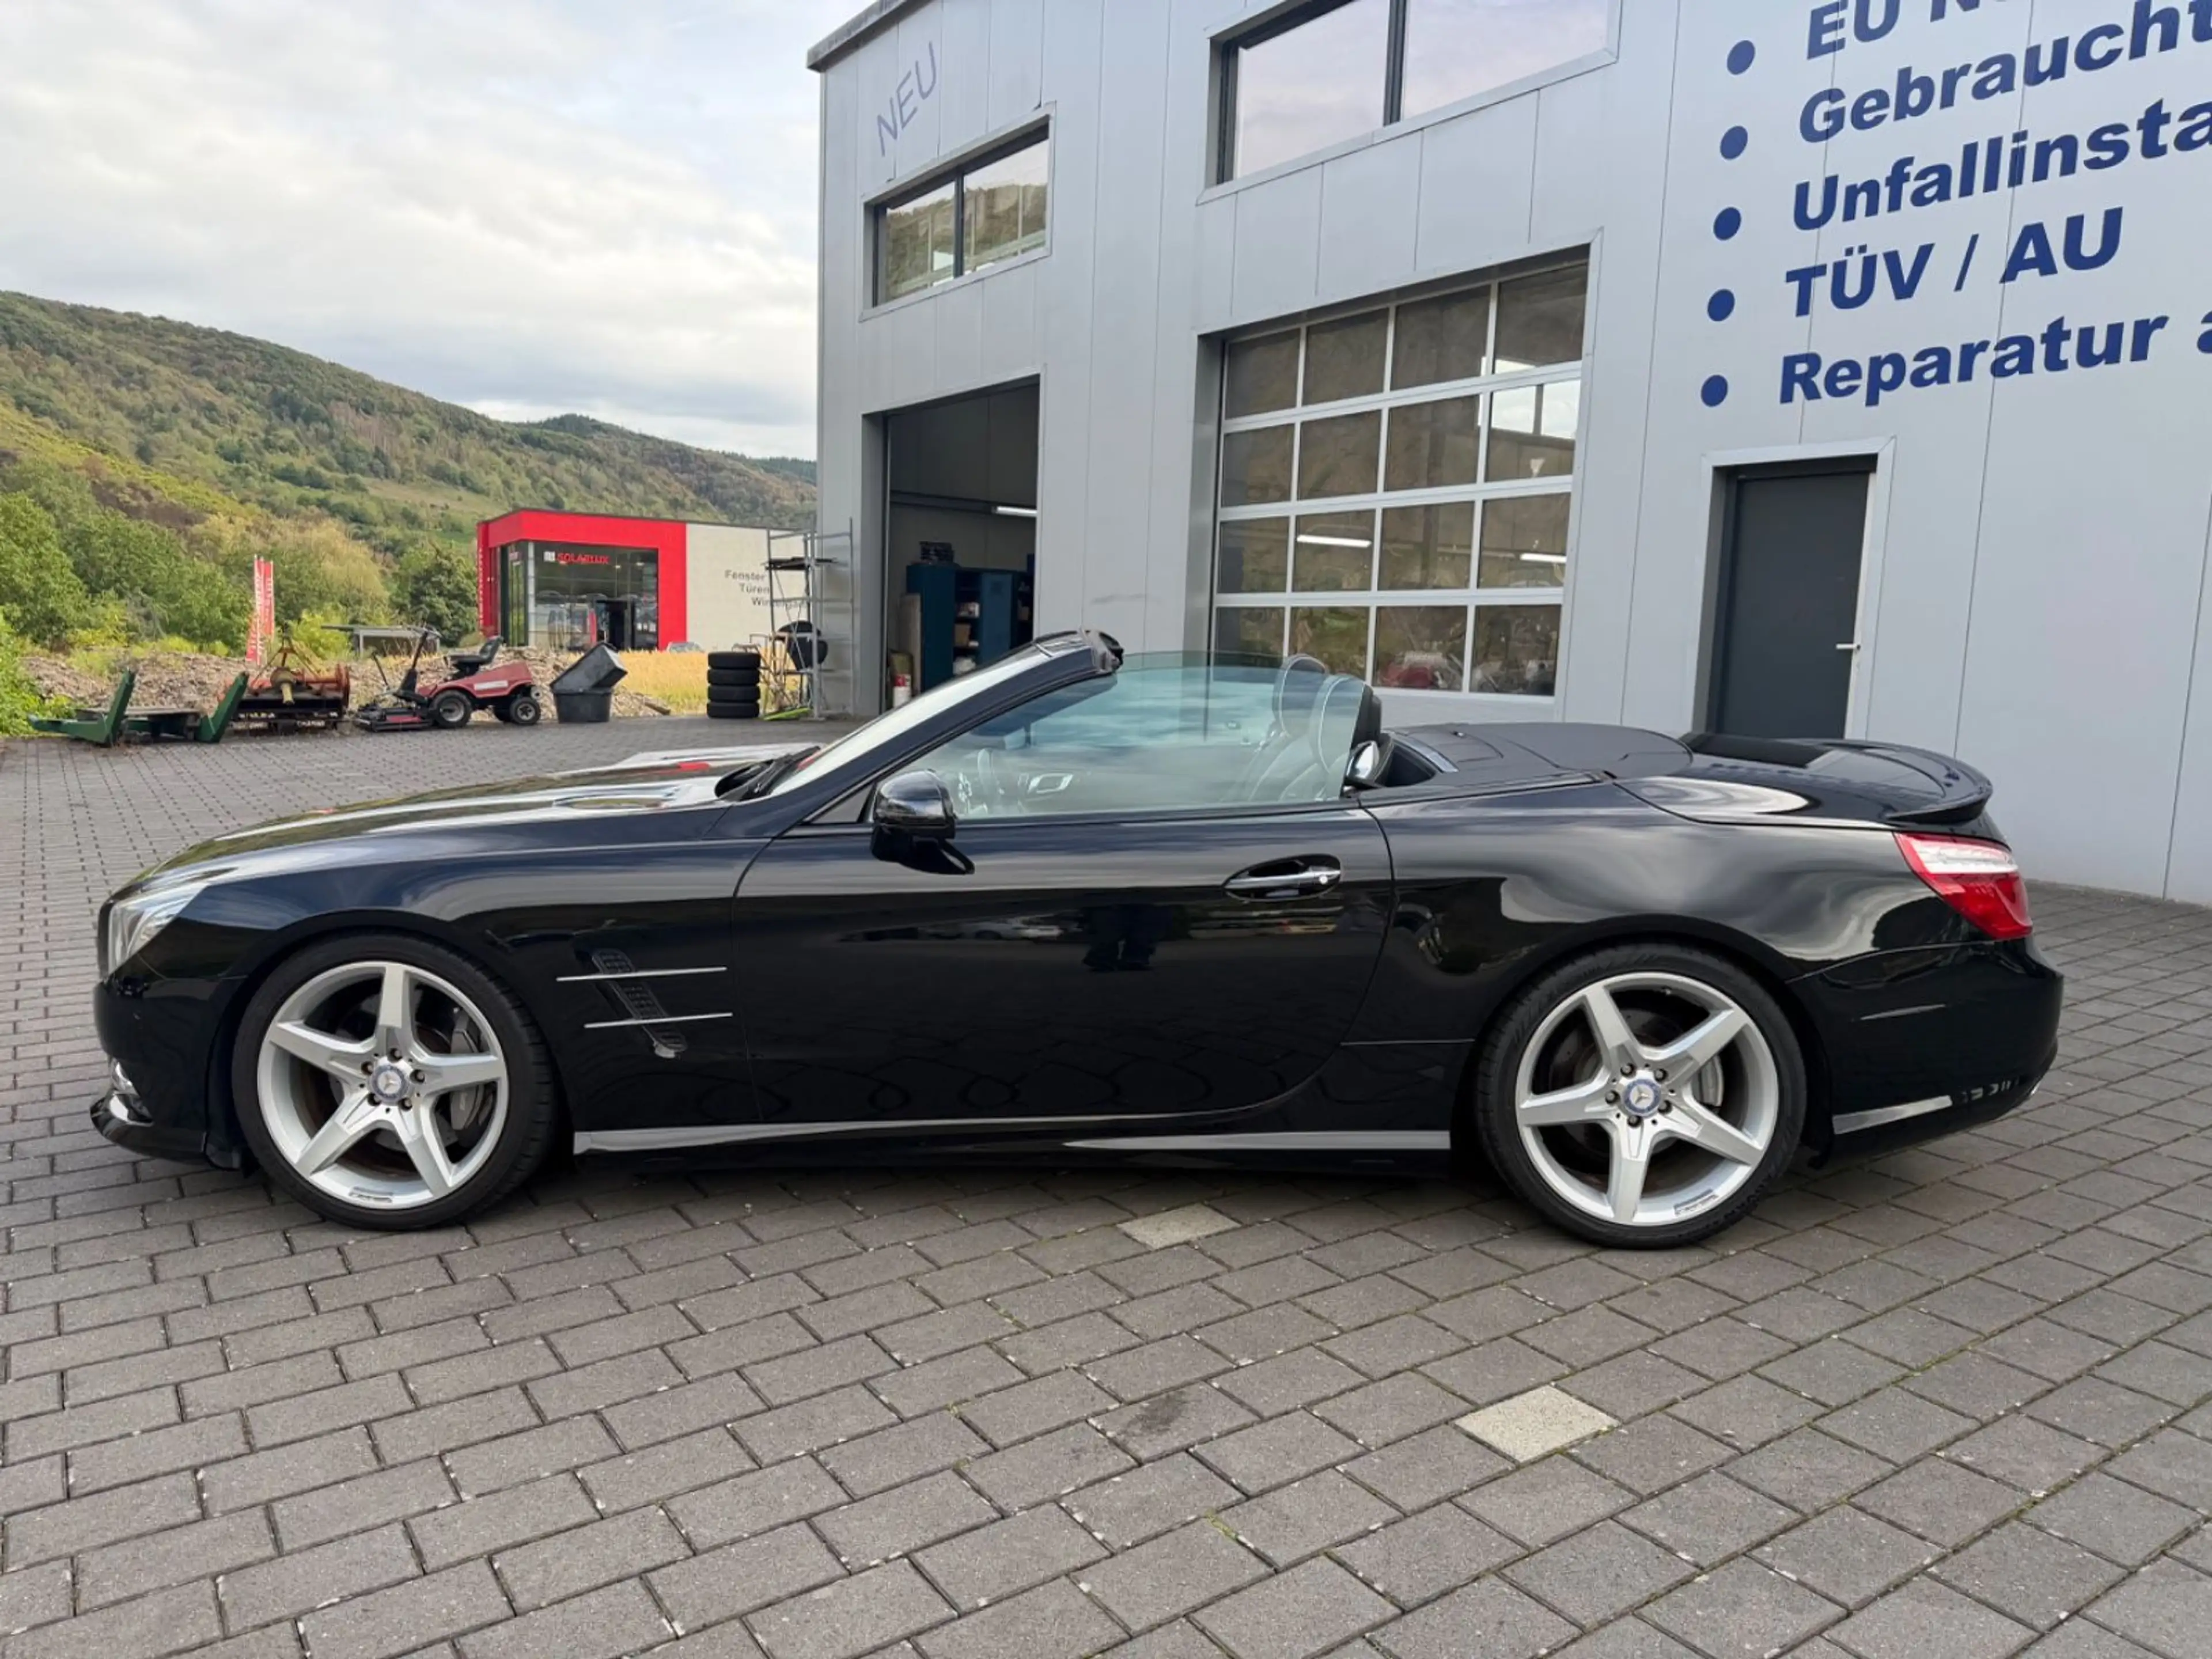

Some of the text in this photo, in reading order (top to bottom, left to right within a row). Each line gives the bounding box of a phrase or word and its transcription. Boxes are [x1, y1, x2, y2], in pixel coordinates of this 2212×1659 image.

[1805, 0, 1903, 60] EU
[876, 40, 937, 158] NEU
[1793, 99, 2212, 231] Unfallinsta
[1785, 206, 2123, 318] TÜV / AU
[1779, 316, 2169, 407] Reparatur
[724, 569, 766, 581] Fenster
